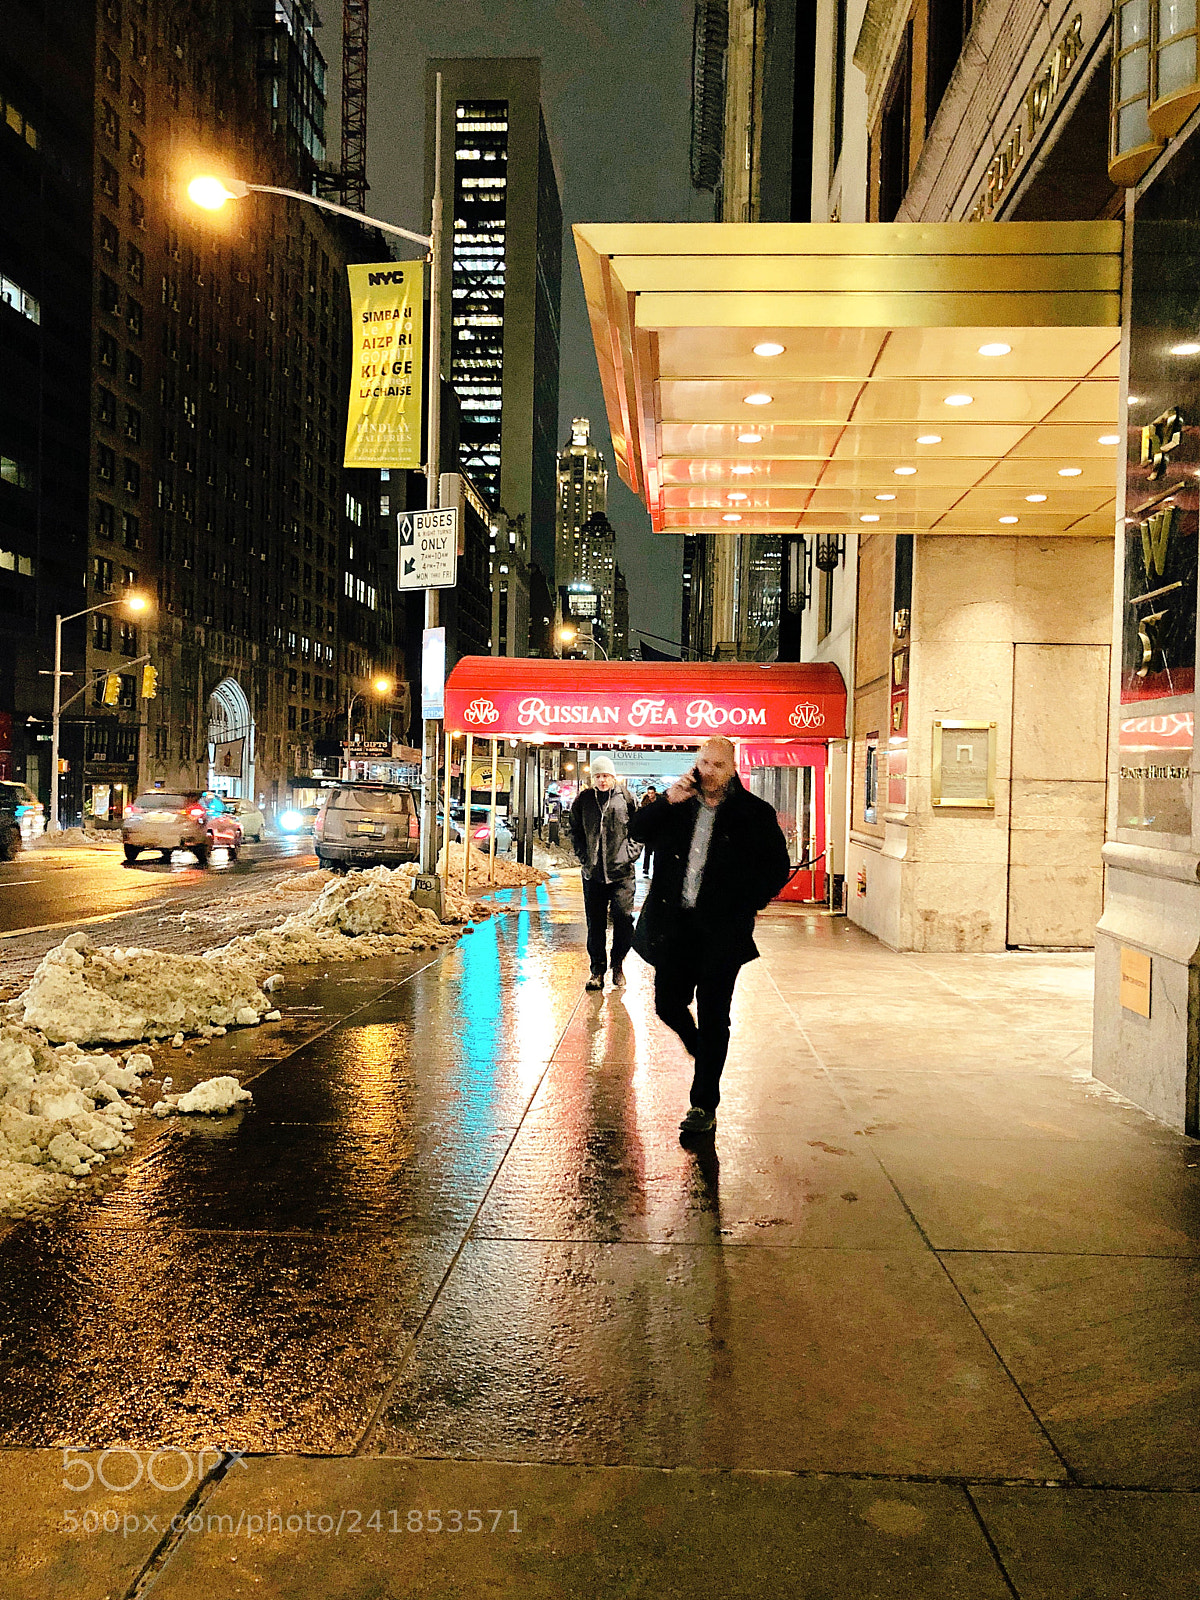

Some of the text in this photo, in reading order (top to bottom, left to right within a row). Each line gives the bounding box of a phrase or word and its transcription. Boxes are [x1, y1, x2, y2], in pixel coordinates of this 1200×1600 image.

[368, 270, 404, 286] NYC
[362, 333, 412, 350] AIZPRI
[361, 361, 412, 378] KLUGE
[360, 386, 412, 398] LACHAISE
[417, 514, 453, 529] BUSES
[421, 537, 447, 551] ONLY
[1140, 506, 1175, 580] W
[442, 571, 452, 579] FRI
